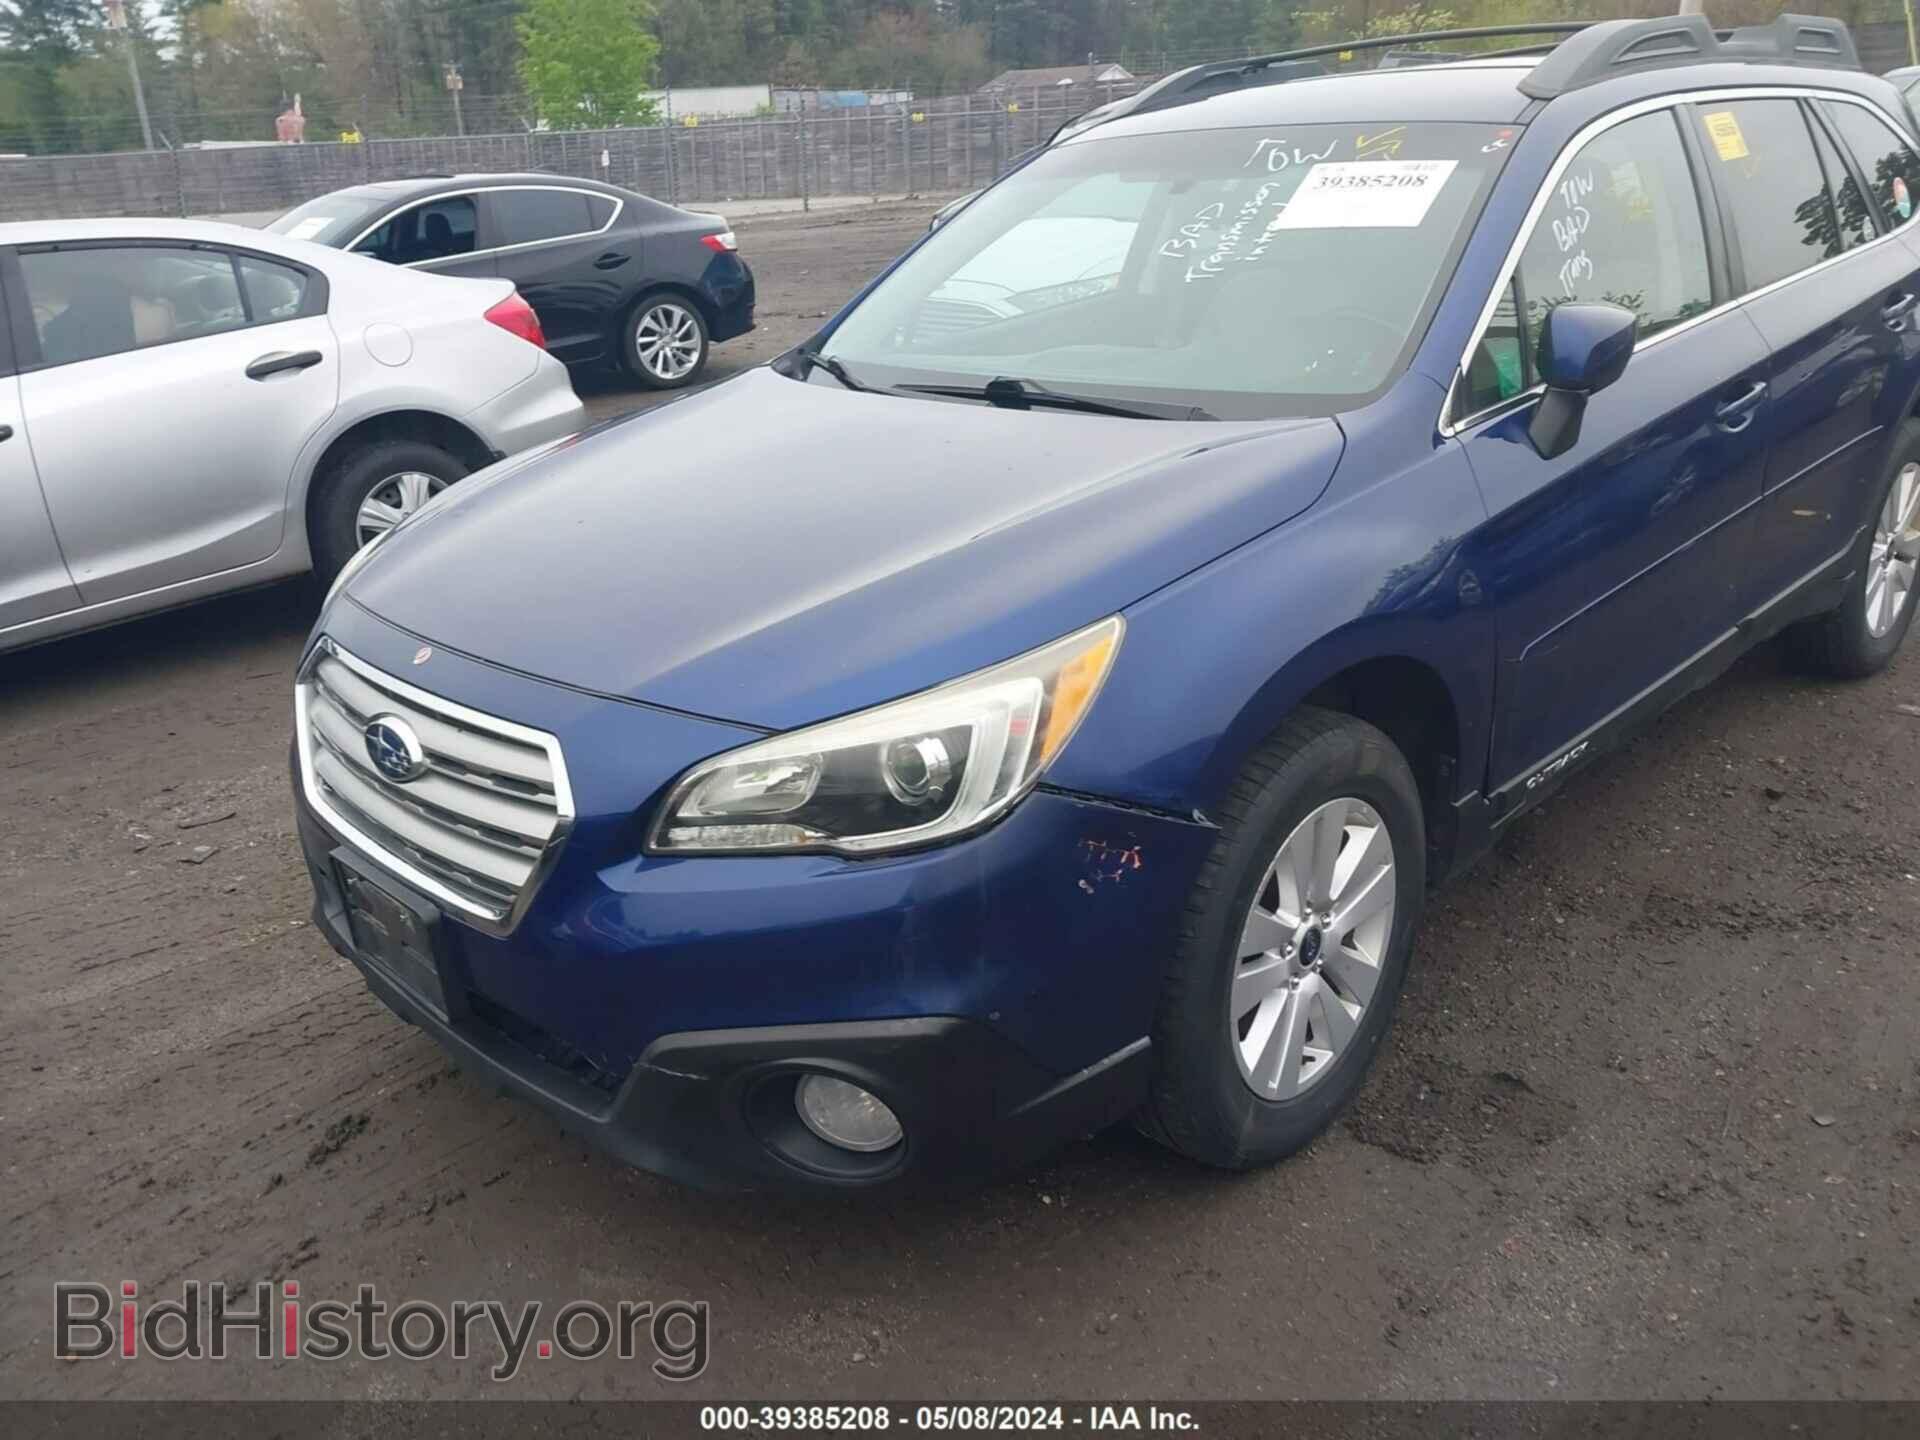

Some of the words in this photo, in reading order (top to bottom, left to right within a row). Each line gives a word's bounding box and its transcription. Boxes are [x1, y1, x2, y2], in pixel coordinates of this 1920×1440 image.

[1312, 174, 1428, 190] 39385208
[1159, 202, 1224, 257] BAD
[1552, 206, 1590, 252] BAD
